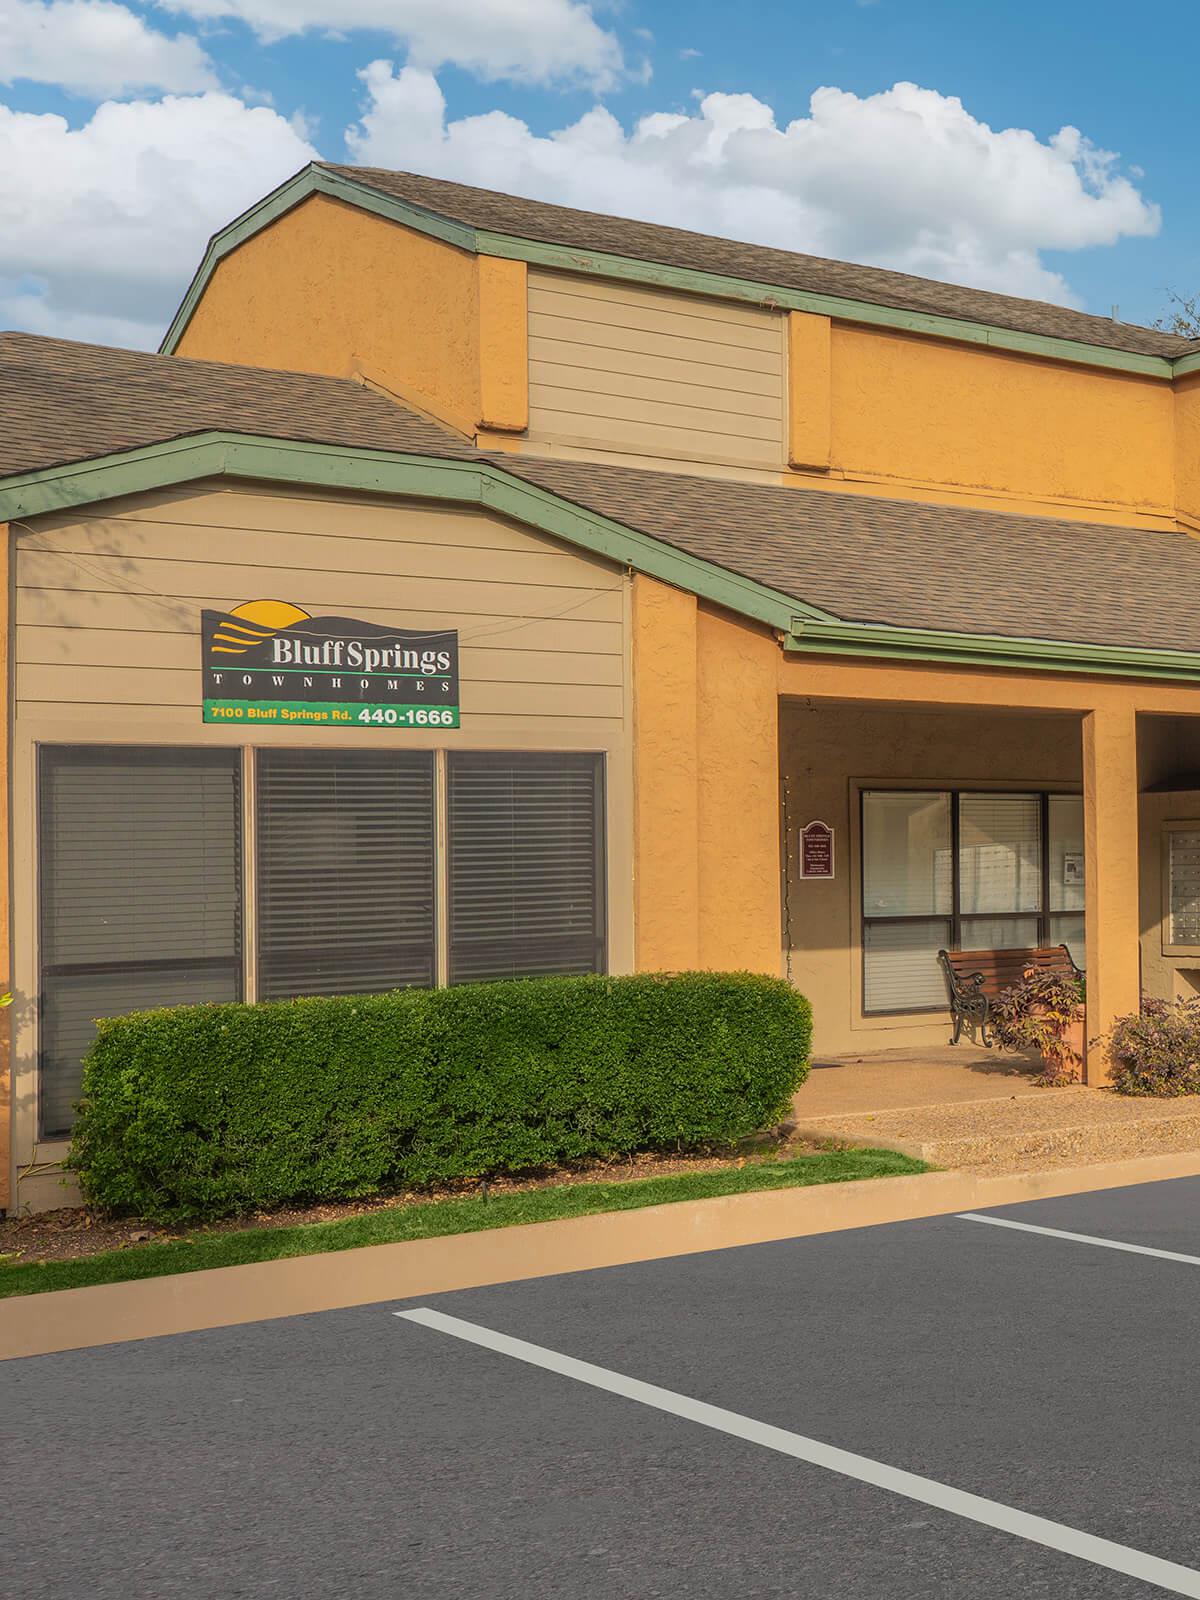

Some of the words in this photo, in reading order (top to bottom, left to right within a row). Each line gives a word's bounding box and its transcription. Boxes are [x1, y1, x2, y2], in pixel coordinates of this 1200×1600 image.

[272, 638, 343, 666] Bluff
[347, 641, 450, 675] Springs
[213, 673, 449, 691] TOWNHOMES
[211, 707, 243, 718] 7100
[247, 707, 277, 719] Bluff
[281, 708, 329, 721] Springs
[332, 710, 352, 721] Rd.
[358, 708, 454, 725] 440-1666
